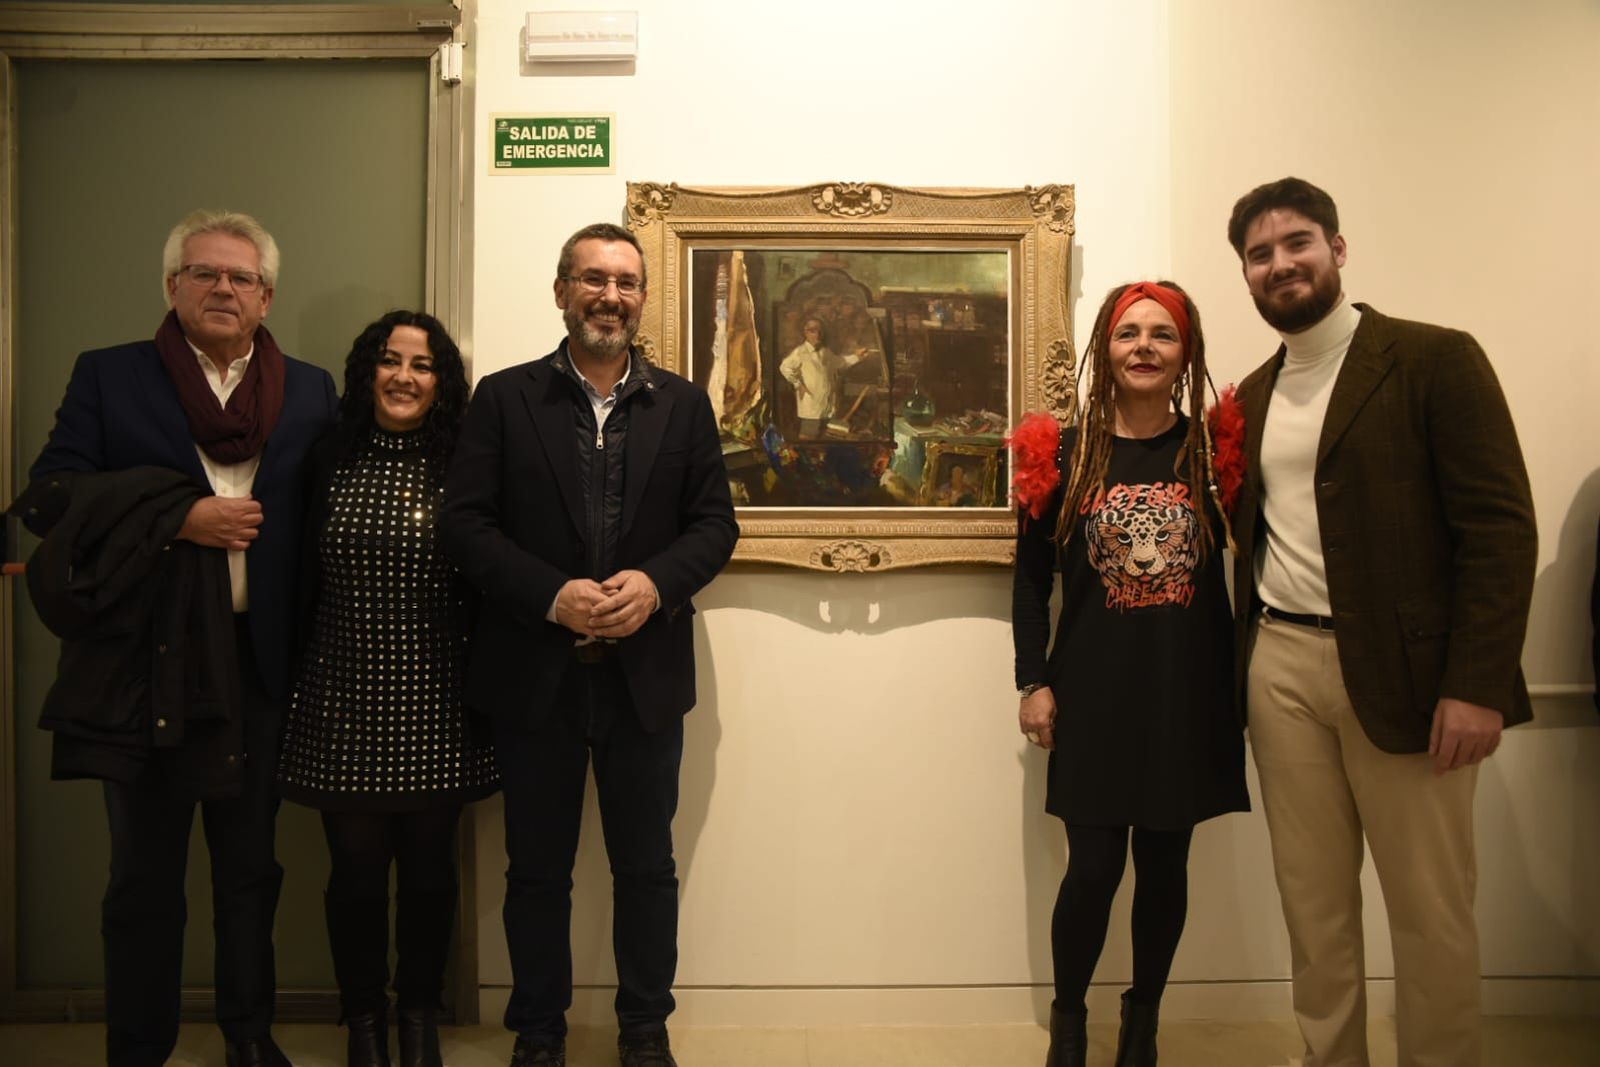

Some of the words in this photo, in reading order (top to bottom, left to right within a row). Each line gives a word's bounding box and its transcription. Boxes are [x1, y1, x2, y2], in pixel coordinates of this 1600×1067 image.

[509, 126, 569, 140] SALIDA
[574, 125, 596, 139] DE
[503, 144, 604, 158] EMERGENCIA
